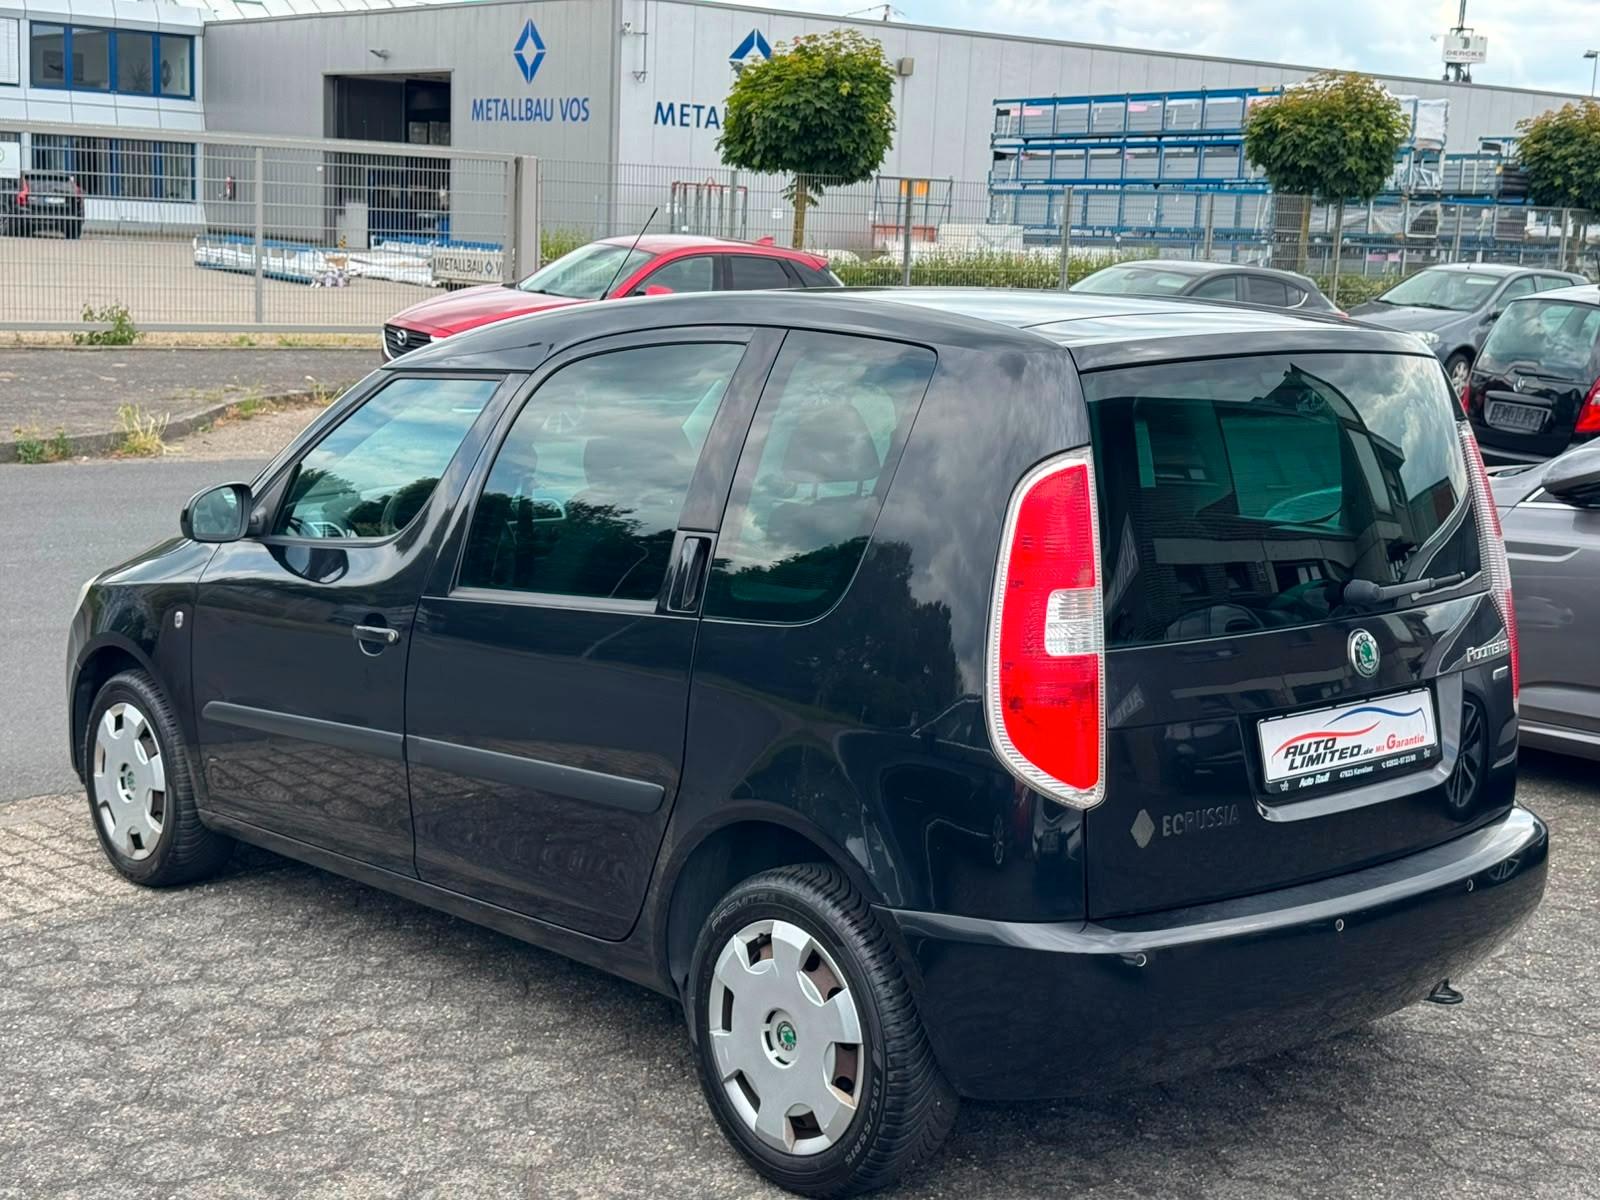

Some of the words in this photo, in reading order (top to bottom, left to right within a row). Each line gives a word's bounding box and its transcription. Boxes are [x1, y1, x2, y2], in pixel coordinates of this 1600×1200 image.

[471, 98, 554, 122] METALLBAU
[560, 97, 590, 122] VOS
[437, 258, 484, 273] METALLBAU
[1284, 737, 1337, 759] AUTO
[1387, 733, 1424, 750] Garantie
[1299, 776, 1314, 788] Auto
